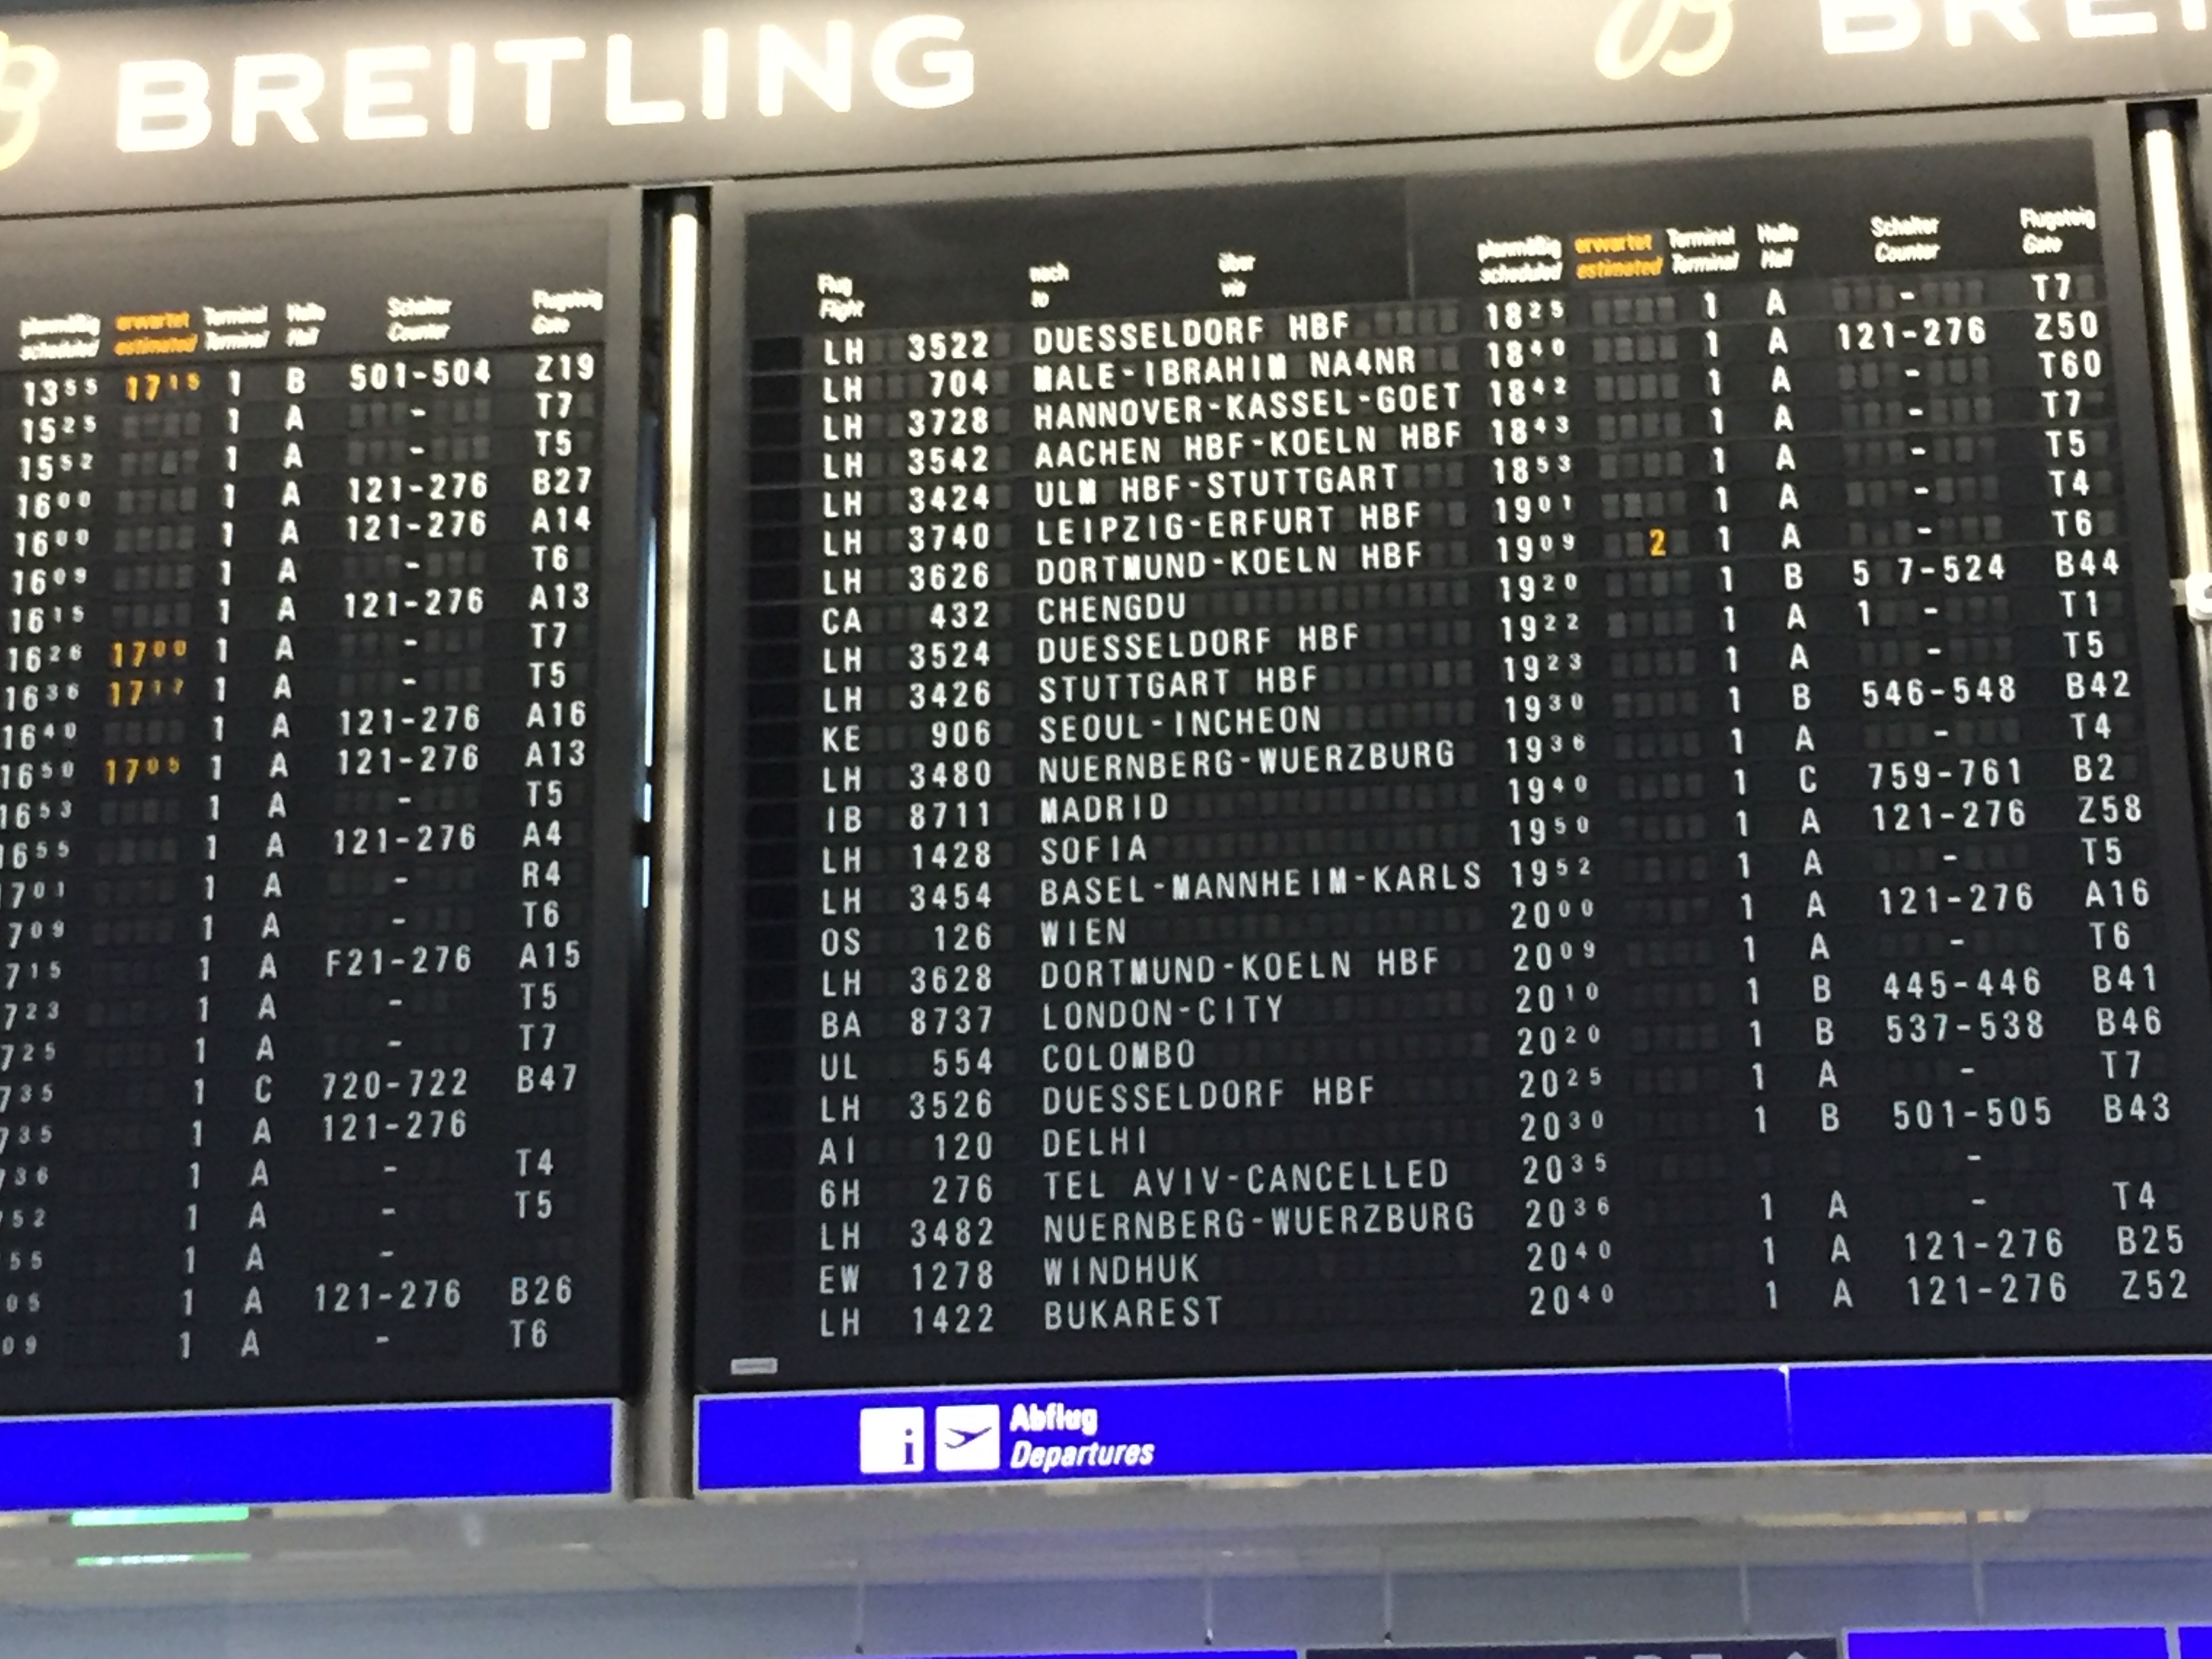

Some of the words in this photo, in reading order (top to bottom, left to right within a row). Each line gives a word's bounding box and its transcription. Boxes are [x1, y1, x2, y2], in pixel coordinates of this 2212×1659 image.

[116, 14, 975, 152] BREITLING
[823, 337, 864, 367] LH
[907, 329, 989, 363] 3522
[1033, 314, 1264, 356] DUESSELDORF
[1288, 310, 1349, 342] HBF
[823, 375, 863, 404] LH
[929, 367, 989, 398] 704
[1033, 352, 1288, 393] MALE-IBRAHIM
[1309, 345, 1416, 378] NA4NR
[1837, 314, 1986, 351] 121-276
[2034, 309, 2099, 342] Z50
[349, 356, 491, 392] 501-504
[534, 352, 594, 383] Z19
[823, 413, 863, 442] LH
[907, 405, 989, 438] 3728
[1033, 381, 1461, 432] HANNOVER-KASSEL-GOET
[2037, 348, 2102, 380] T60
[823, 451, 863, 480] LH
[907, 444, 989, 476] 3542
[1034, 436, 1161, 470] AACHEN
[1184, 425, 1376, 462] HBF-KOELN
[1400, 419, 1461, 451] HBF
[348, 470, 488, 504] 121-276
[532, 465, 592, 496] B27
[823, 490, 863, 518] LH
[908, 483, 990, 514] 3424
[1035, 477, 1097, 508] ULM
[1120, 462, 1398, 504] HBF-STUTTGART
[346, 509, 487, 542] 121-276
[531, 505, 592, 534] A14
[823, 529, 862, 557] LH
[907, 521, 989, 553] 3740
[1036, 505, 1334, 546] LEIPZIG-ERFURT
[1359, 500, 1421, 531] HBF
[821, 606, 863, 636] CA
[929, 600, 989, 630] 432
[1037, 592, 1186, 626] CHENGDU
[2055, 548, 2120, 578] B44
[823, 567, 862, 596] LH
[908, 560, 989, 592] 3626
[1036, 545, 1337, 586] DORTMUND-KOELN
[1361, 540, 1422, 571] HBF
[344, 586, 484, 619] 121-276
[529, 581, 590, 611] A13
[823, 646, 862, 674] LH
[908, 639, 990, 671] 3524
[1037, 626, 1271, 665] DUESSELDORF
[1298, 622, 1359, 653] HBF
[822, 724, 861, 753] KE
[931, 718, 991, 749] 906
[1039, 705, 1321, 744] SEOUL-INCHEON
[1862, 674, 2016, 709] 546-548
[2066, 669, 2131, 700] B42
[823, 685, 862, 714] LH
[909, 679, 991, 710] 3426
[1039, 668, 1230, 704] STUTTGART
[1256, 664, 1317, 694] HBF
[340, 703, 480, 736] 121-276
[526, 699, 586, 729] A16
[338, 743, 478, 775] 121-276
[525, 739, 586, 768] A13
[822, 765, 861, 794] LH
[909, 759, 991, 790] 3480
[1038, 739, 1454, 784] NUERNBERG-WUERZBURG
[827, 804, 862, 834] IB
[909, 800, 989, 831] 8711
[1040, 792, 1168, 825] MADRID
[1868, 756, 2021, 790] 759-761
[334, 823, 476, 855] 121-276
[822, 846, 861, 875] LH
[912, 840, 991, 870] 1428
[1040, 834, 1147, 866] SOFIA
[1872, 798, 2026, 832] 121-276
[2078, 793, 2142, 824] Z58
[822, 886, 861, 916] LH
[909, 881, 992, 912] 3454
[1040, 860, 1481, 907] BASEL-MANNHEIM-KARLS
[821, 927, 861, 957] OS
[934, 922, 992, 952] 126
[1040, 917, 1126, 948] WIEN
[1879, 882, 2034, 916] 121-276
[2085, 878, 2150, 908] A16
[326, 944, 472, 978] F21-276
[518, 939, 581, 969] A15
[822, 968, 861, 998] LH
[909, 963, 992, 995] 3628
[1040, 950, 1351, 989] DORTMUND-KOELN
[1377, 946, 1438, 977] HBF
[821, 1010, 862, 1040] BA
[910, 1005, 992, 1036] 8737
[1043, 994, 1283, 1031] LONDON-CITY
[1883, 966, 2041, 1000] 445-446
[2092, 963, 2156, 994] B41
[820, 1052, 858, 1082] UL
[933, 1046, 993, 1078] 554
[1042, 1038, 1195, 1073] COLOMBO
[1886, 1009, 2044, 1044] 537-538
[2095, 1005, 2162, 1037] B46
[323, 1067, 467, 1101] 720-722
[516, 1063, 577, 1094] B47
[821, 1094, 860, 1124] LH
[909, 1088, 992, 1120] 3526
[1042, 1078, 1284, 1115] DUESSELDORF
[1313, 1075, 1374, 1106] HBF
[323, 1108, 466, 1142] 121-276
[818, 1136, 855, 1166] AI
[935, 1131, 993, 1161] 120
[1042, 1126, 1146, 1158] DELHI
[1893, 1096, 2051, 1131] 501-505
[2103, 1092, 2171, 1124] B43
[820, 1178, 860, 1209] 6H
[932, 1173, 993, 1204] 276
[1044, 1170, 1105, 1201] TEL
[1132, 1158, 1448, 1197] AVIV-CANCELLED
[820, 1221, 861, 1251] LH
[910, 1216, 994, 1248] 3482
[1044, 1200, 1474, 1244] NUERNBERG-WUERZBURG
[819, 1264, 859, 1294] EW
[912, 1259, 994, 1292] 1278
[1044, 1253, 1200, 1287] WINDHUK
[1904, 1227, 2064, 1262] 121-276
[2116, 1224, 2184, 1256] B25
[315, 1278, 462, 1313] 121-276
[510, 1274, 572, 1306] B26
[820, 1307, 860, 1338] LH
[913, 1303, 994, 1334] 1422
[1044, 1294, 1223, 1331] BUKAREST
[1907, 1271, 2067, 1306] 121-276
[2121, 1268, 2188, 1300] Z52
[1009, 1401, 1099, 1437] Abflug
[1009, 1439, 1156, 1475] Departures
